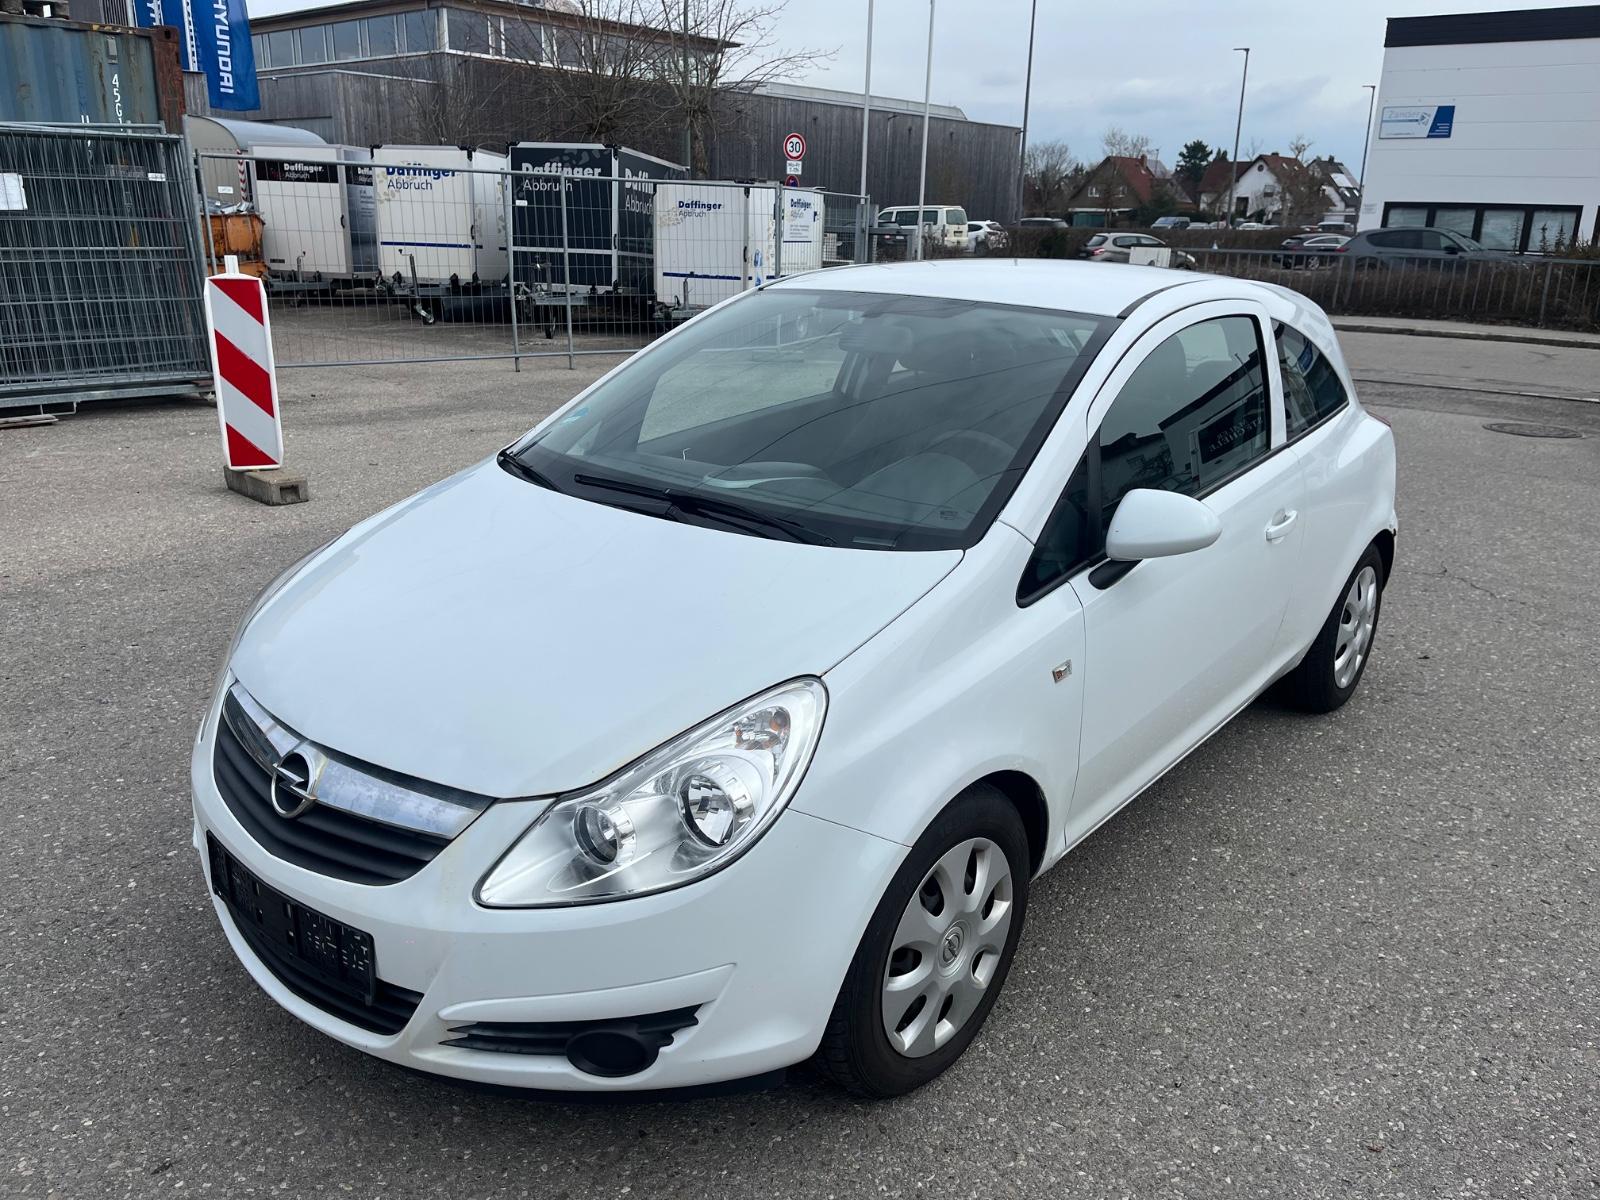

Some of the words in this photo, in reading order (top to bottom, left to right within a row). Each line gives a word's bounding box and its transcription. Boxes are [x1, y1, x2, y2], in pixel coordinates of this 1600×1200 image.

[213, 0, 234, 94] HYUNDAI
[788, 140, 801, 153] 30
[387, 179, 433, 190] Abbruch
[522, 179, 573, 192] Abbruh
